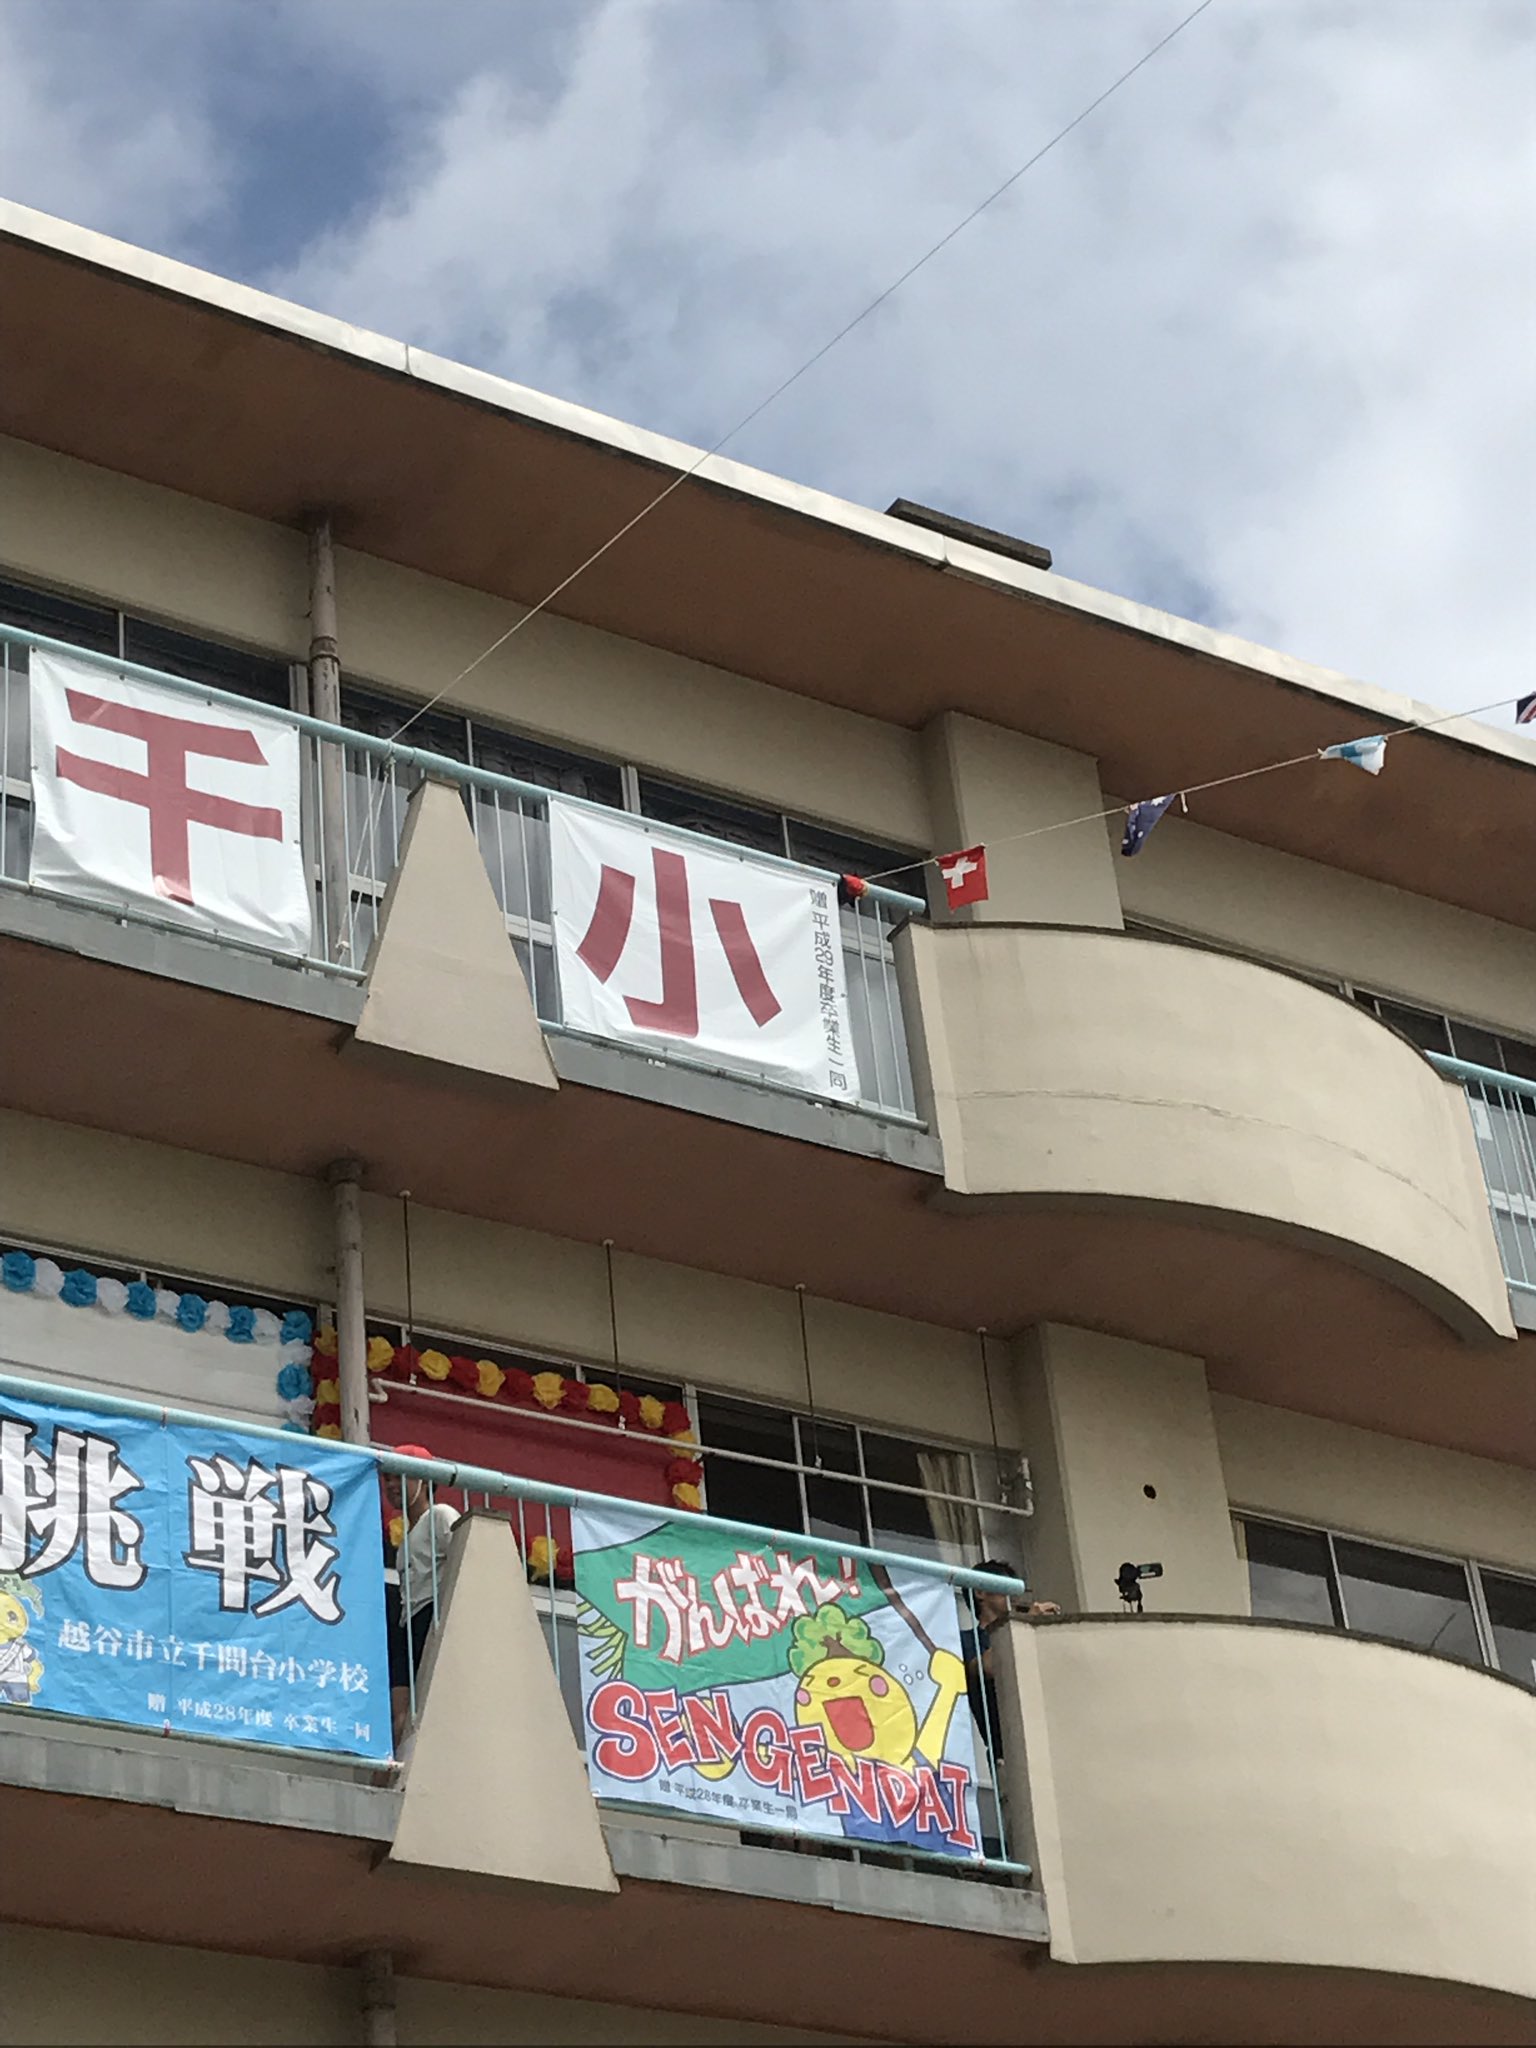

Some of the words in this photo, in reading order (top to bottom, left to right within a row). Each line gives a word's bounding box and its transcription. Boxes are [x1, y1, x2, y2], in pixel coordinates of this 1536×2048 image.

[576, 847, 782, 1038] 小
[58, 1618, 370, 1695] 越谷市立千間台小学校
